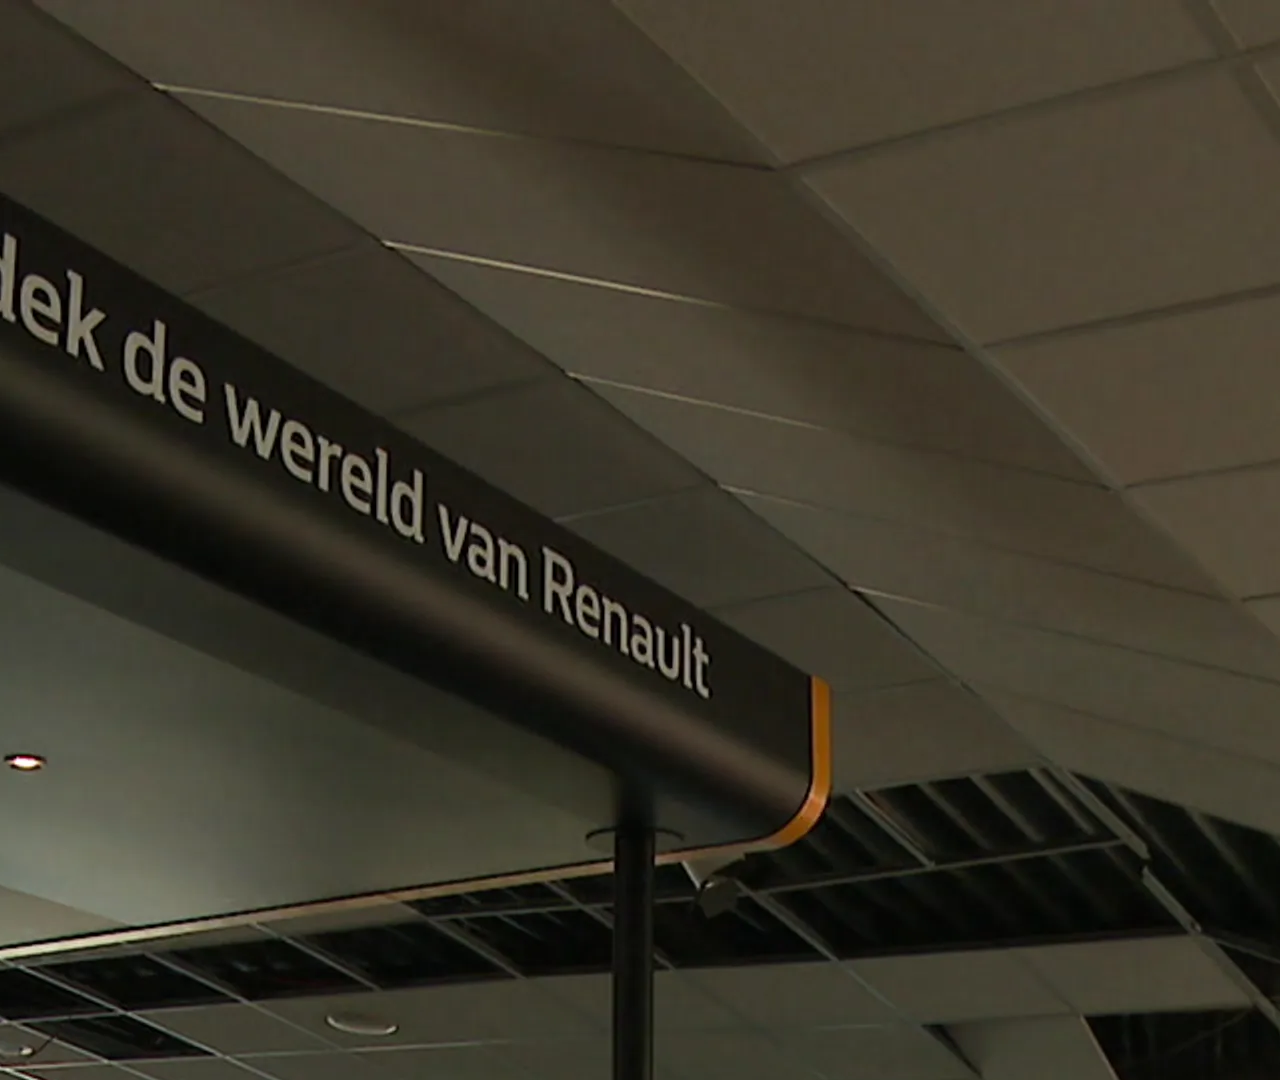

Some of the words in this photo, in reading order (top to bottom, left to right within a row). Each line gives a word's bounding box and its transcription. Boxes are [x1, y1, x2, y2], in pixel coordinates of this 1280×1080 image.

[124, 320, 206, 424] de
[224, 383, 424, 543] wereld
[439, 505, 529, 600] van
[542, 547, 710, 699] Renault
